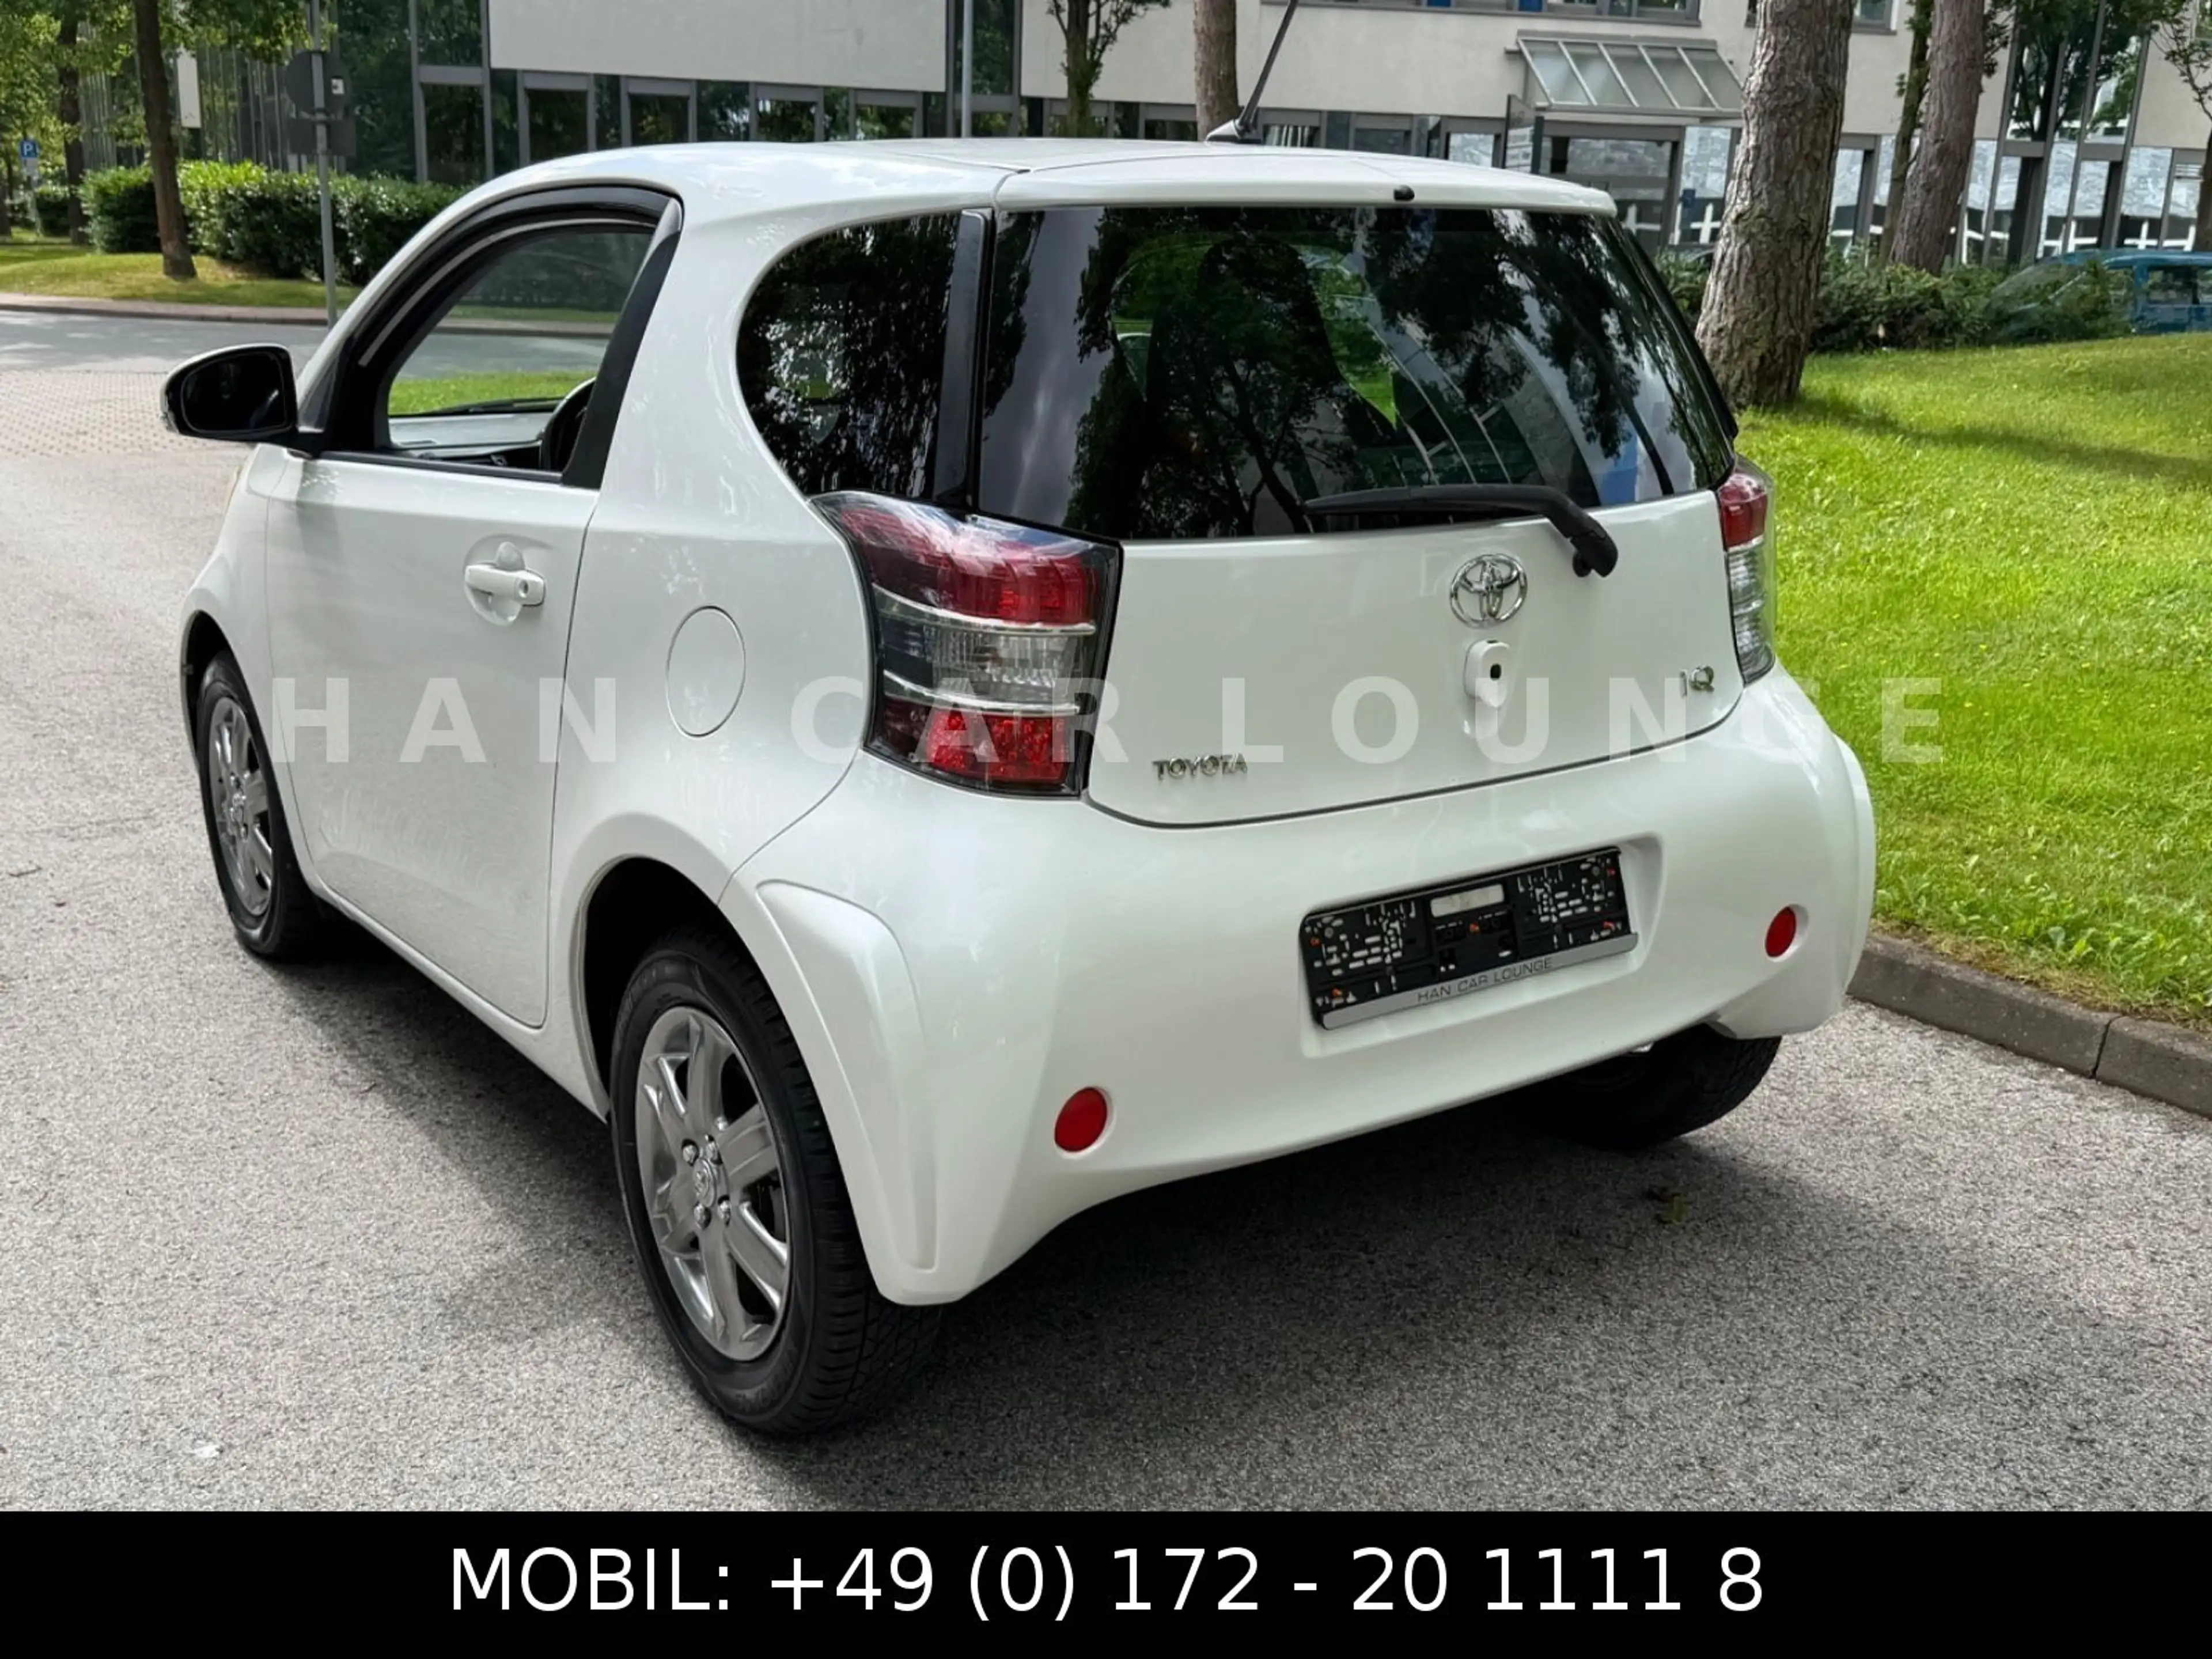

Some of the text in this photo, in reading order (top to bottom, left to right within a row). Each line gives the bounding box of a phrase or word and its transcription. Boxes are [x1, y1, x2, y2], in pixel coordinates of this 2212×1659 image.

[24, 141, 33, 156] P
[1152, 753, 1248, 781] TOYOTA
[1417, 957, 1552, 1002] HAN CAR LOUNGE
